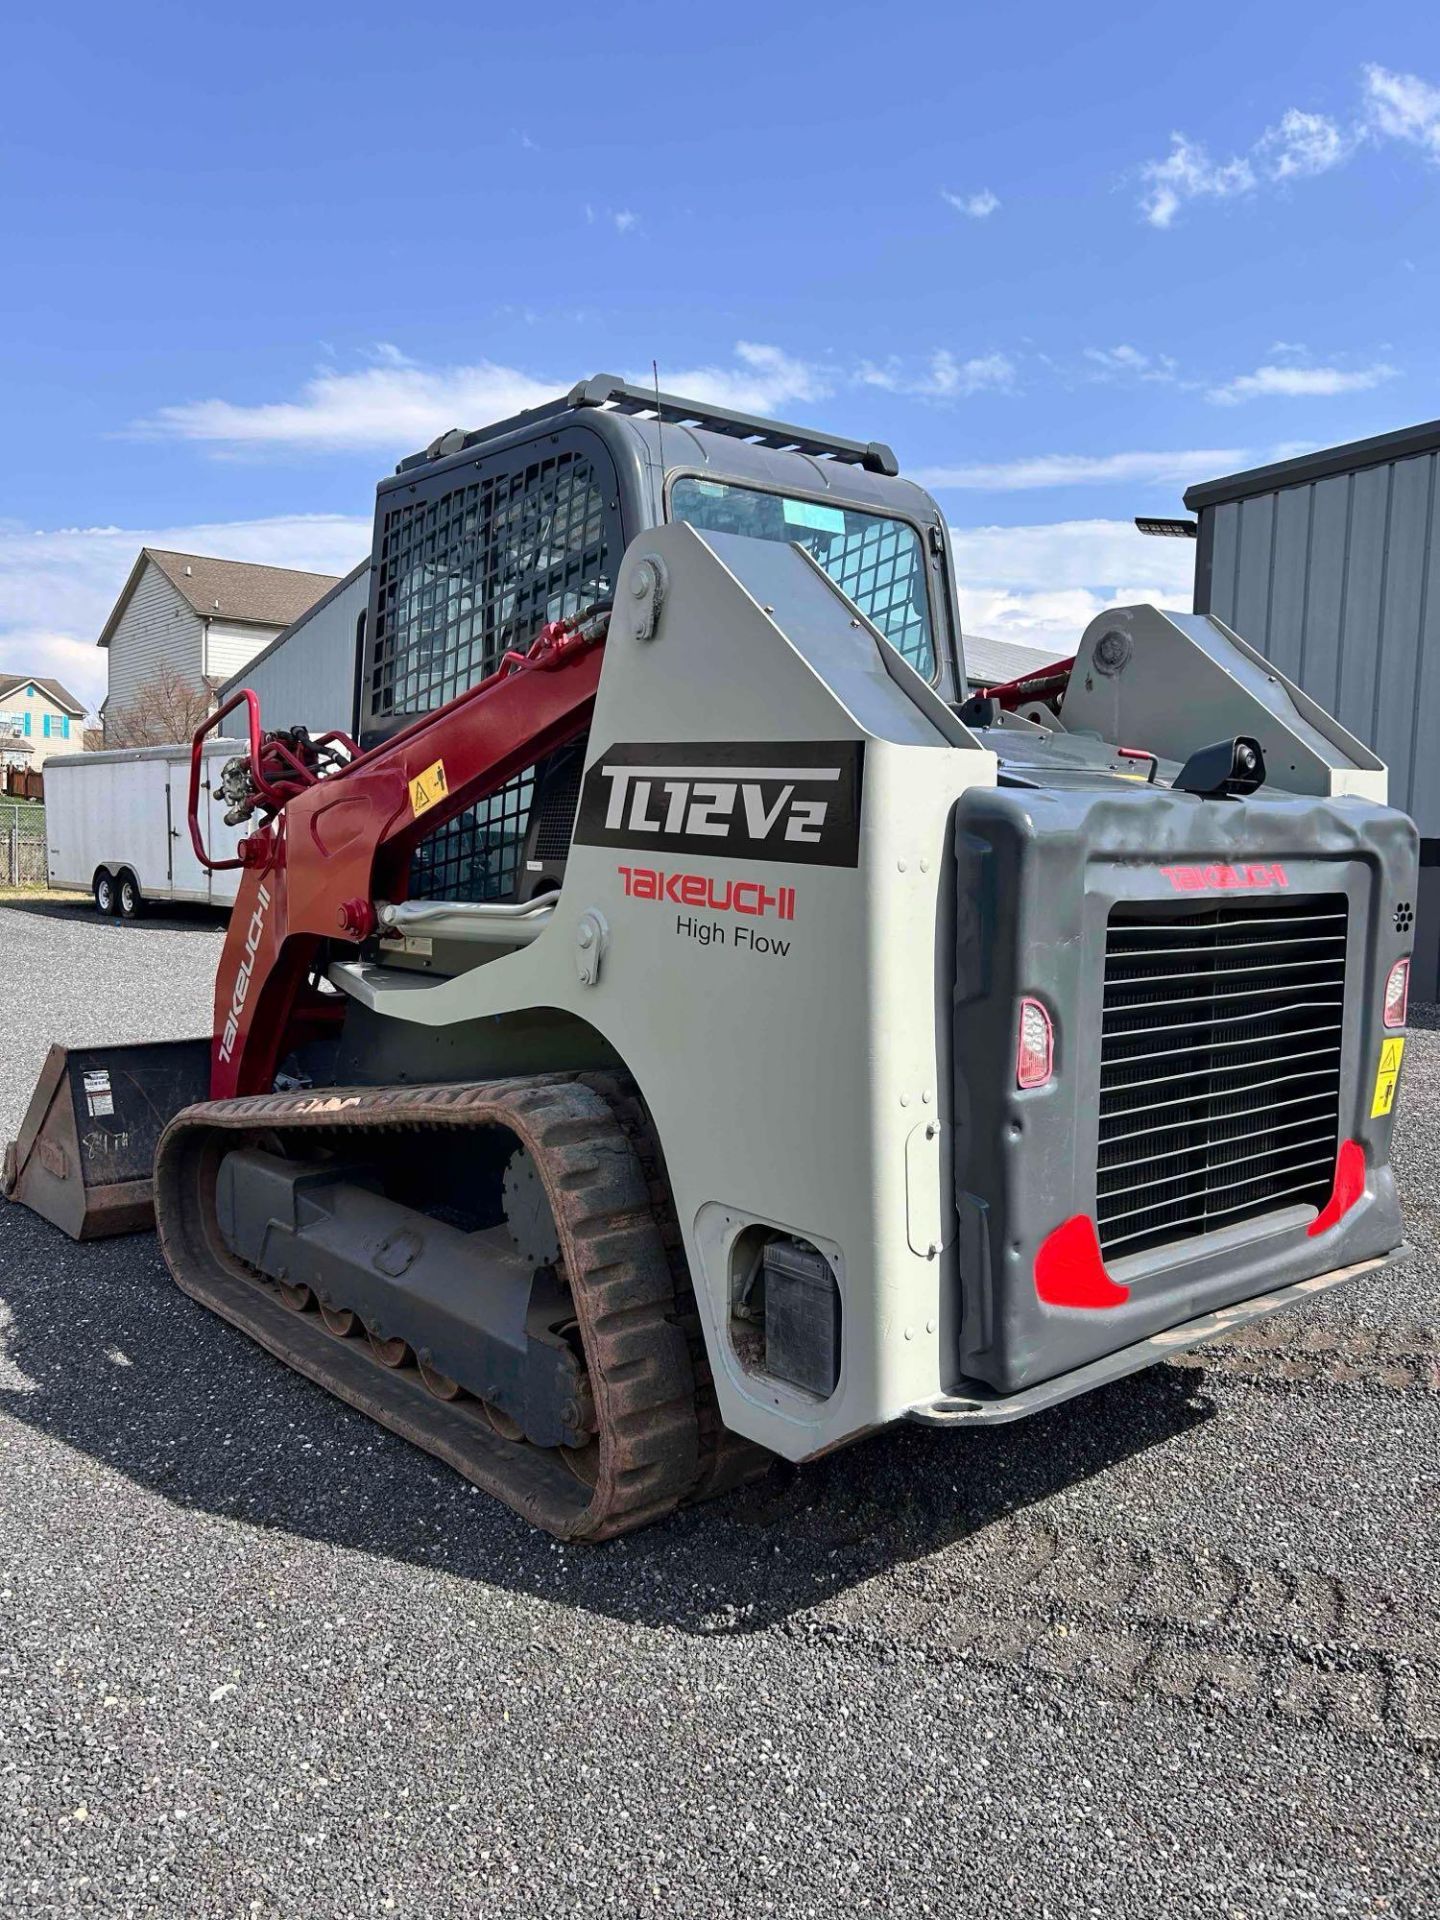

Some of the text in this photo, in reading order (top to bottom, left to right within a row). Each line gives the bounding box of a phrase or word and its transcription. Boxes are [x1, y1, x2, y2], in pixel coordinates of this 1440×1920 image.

[601, 766, 841, 843] TL12V2
[617, 866, 796, 921] TAKEUCHI
[676, 915, 791, 957] High Flow
[218, 884, 271, 1064] TAKEUCHI
